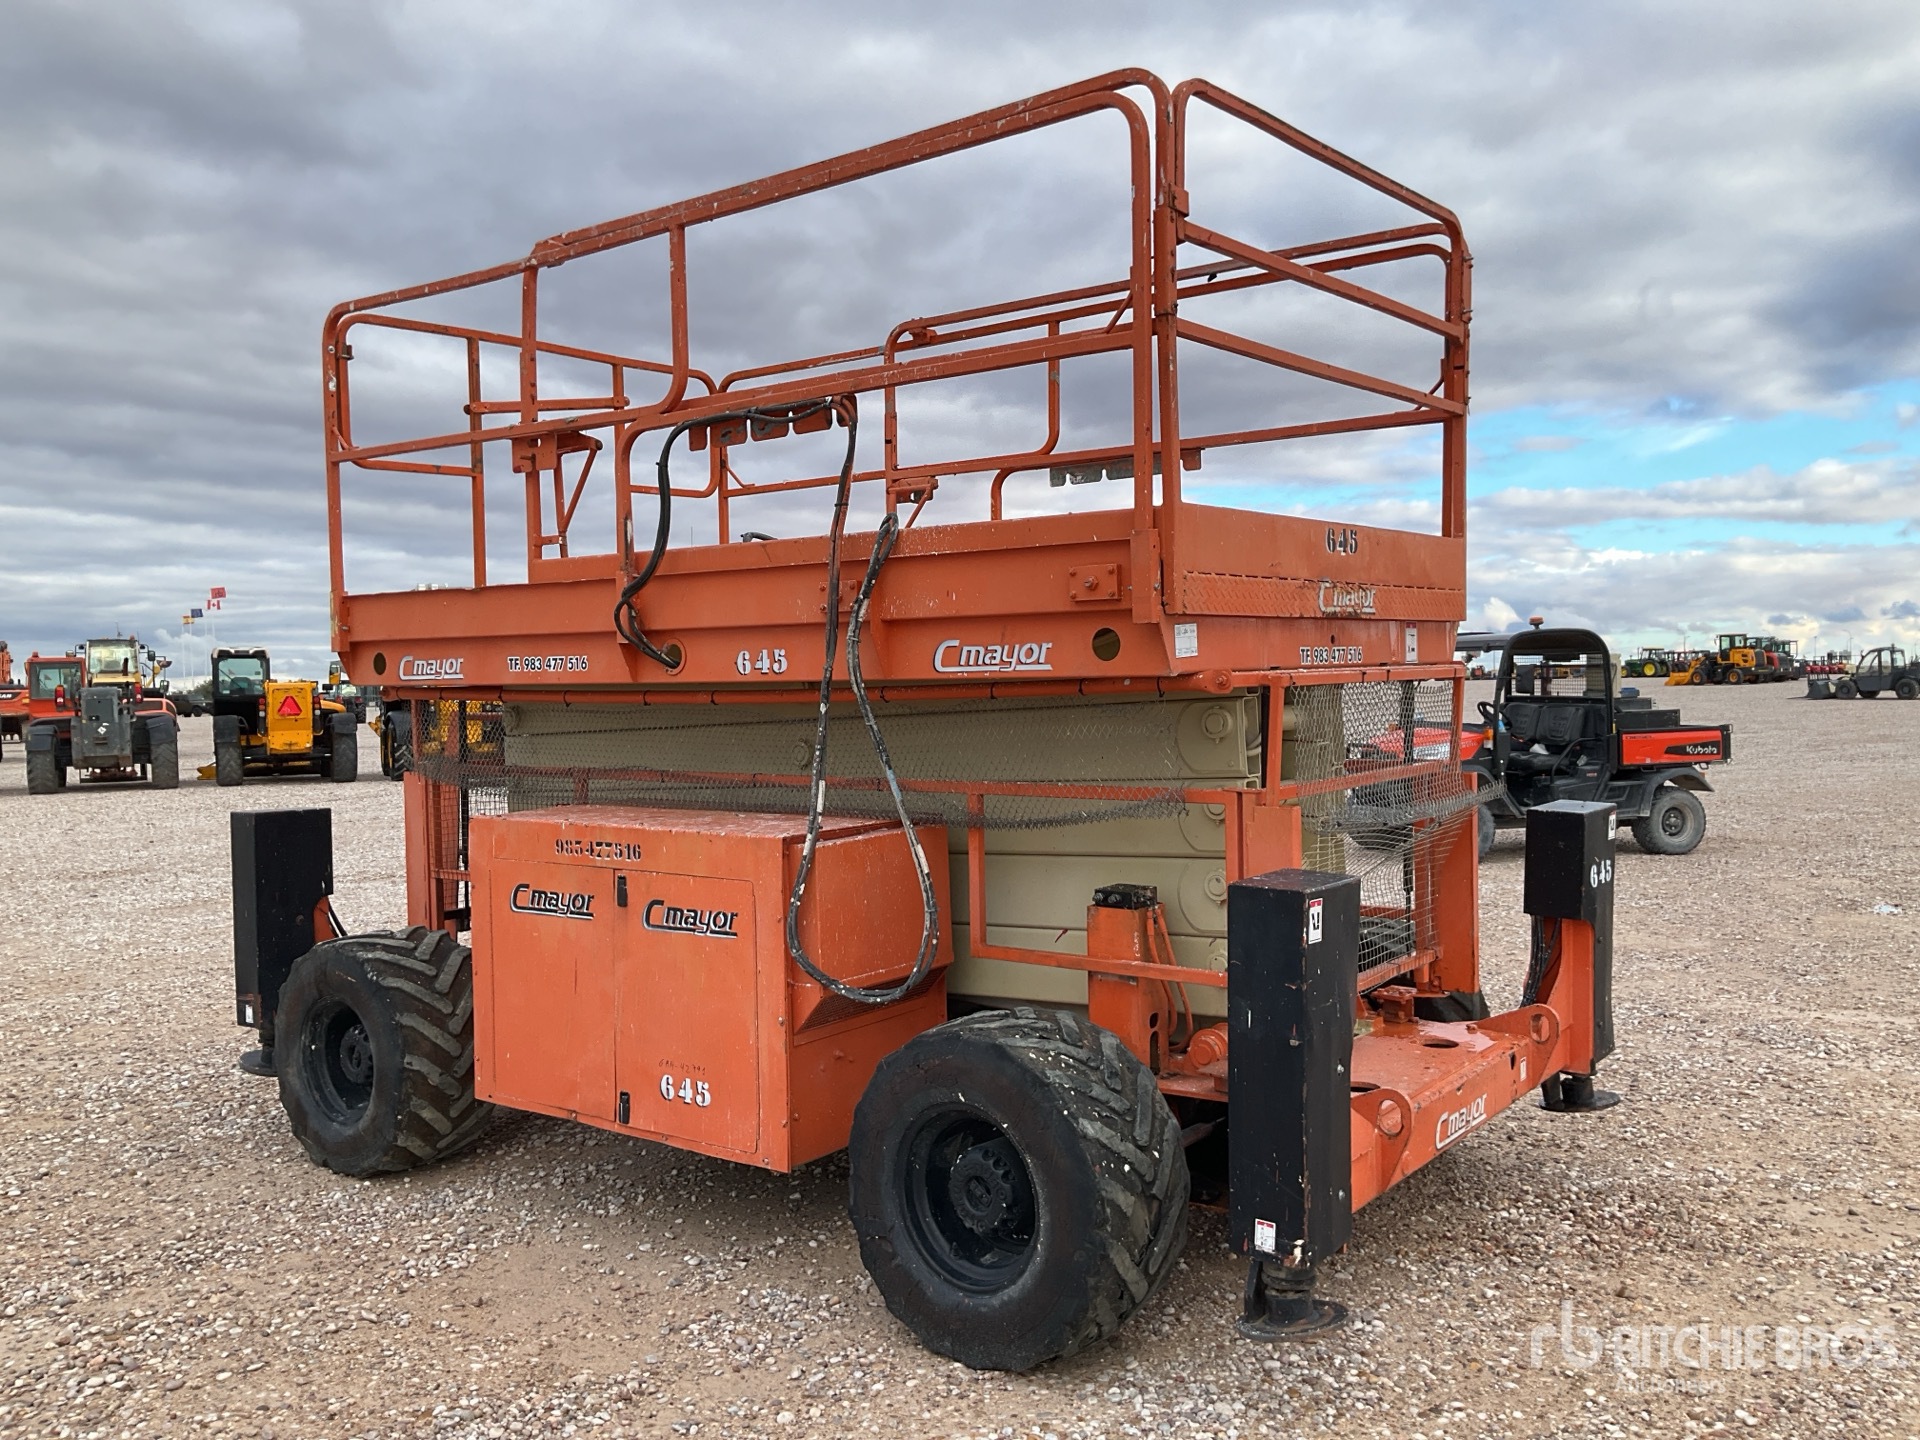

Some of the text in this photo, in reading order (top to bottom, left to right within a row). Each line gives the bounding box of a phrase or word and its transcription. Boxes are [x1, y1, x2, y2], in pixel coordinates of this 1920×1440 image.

[1326, 528, 1358, 555] 645
[1318, 577, 1376, 614] Cmayor
[398, 655, 464, 680] Cmayor
[508, 656, 588, 671] TF. 983 477 516
[735, 649, 788, 675] 645
[933, 639, 1053, 673] Cmayor
[1313, 647, 1329, 664] 983
[1331, 647, 1346, 663] 477
[1348, 646, 1362, 663] 516
[1686, 745, 1718, 754] Kubota
[1590, 860, 1612, 888] 645
[510, 883, 595, 919] Cmayor
[642, 899, 738, 938] Cmayor
[660, 1074, 711, 1107] 645
[1435, 1093, 1487, 1150] Cmayor
